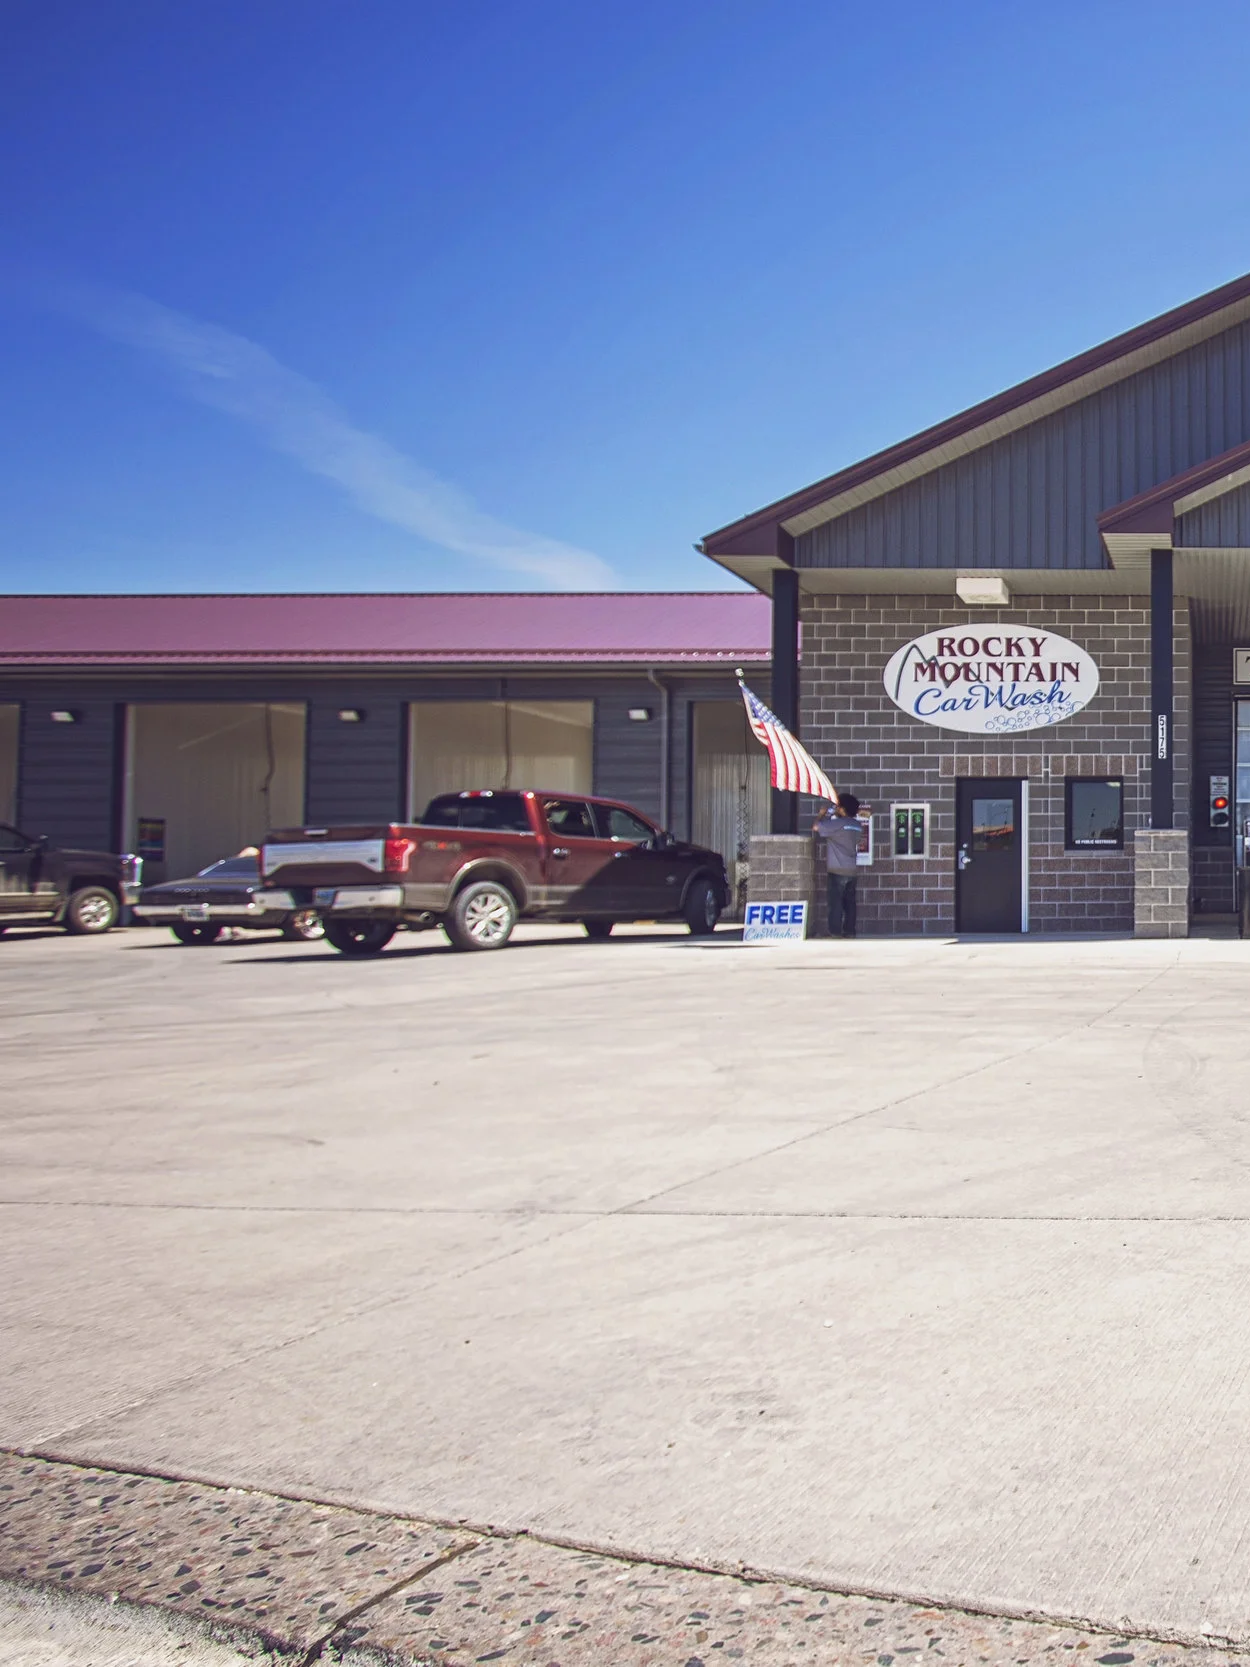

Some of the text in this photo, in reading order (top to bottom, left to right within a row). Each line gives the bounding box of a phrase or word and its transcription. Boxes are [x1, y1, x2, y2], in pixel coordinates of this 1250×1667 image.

[936, 636, 1048, 658] ROCKY
[913, 661, 1081, 683] MOUNTAIN
[746, 905, 804, 926] FREE
